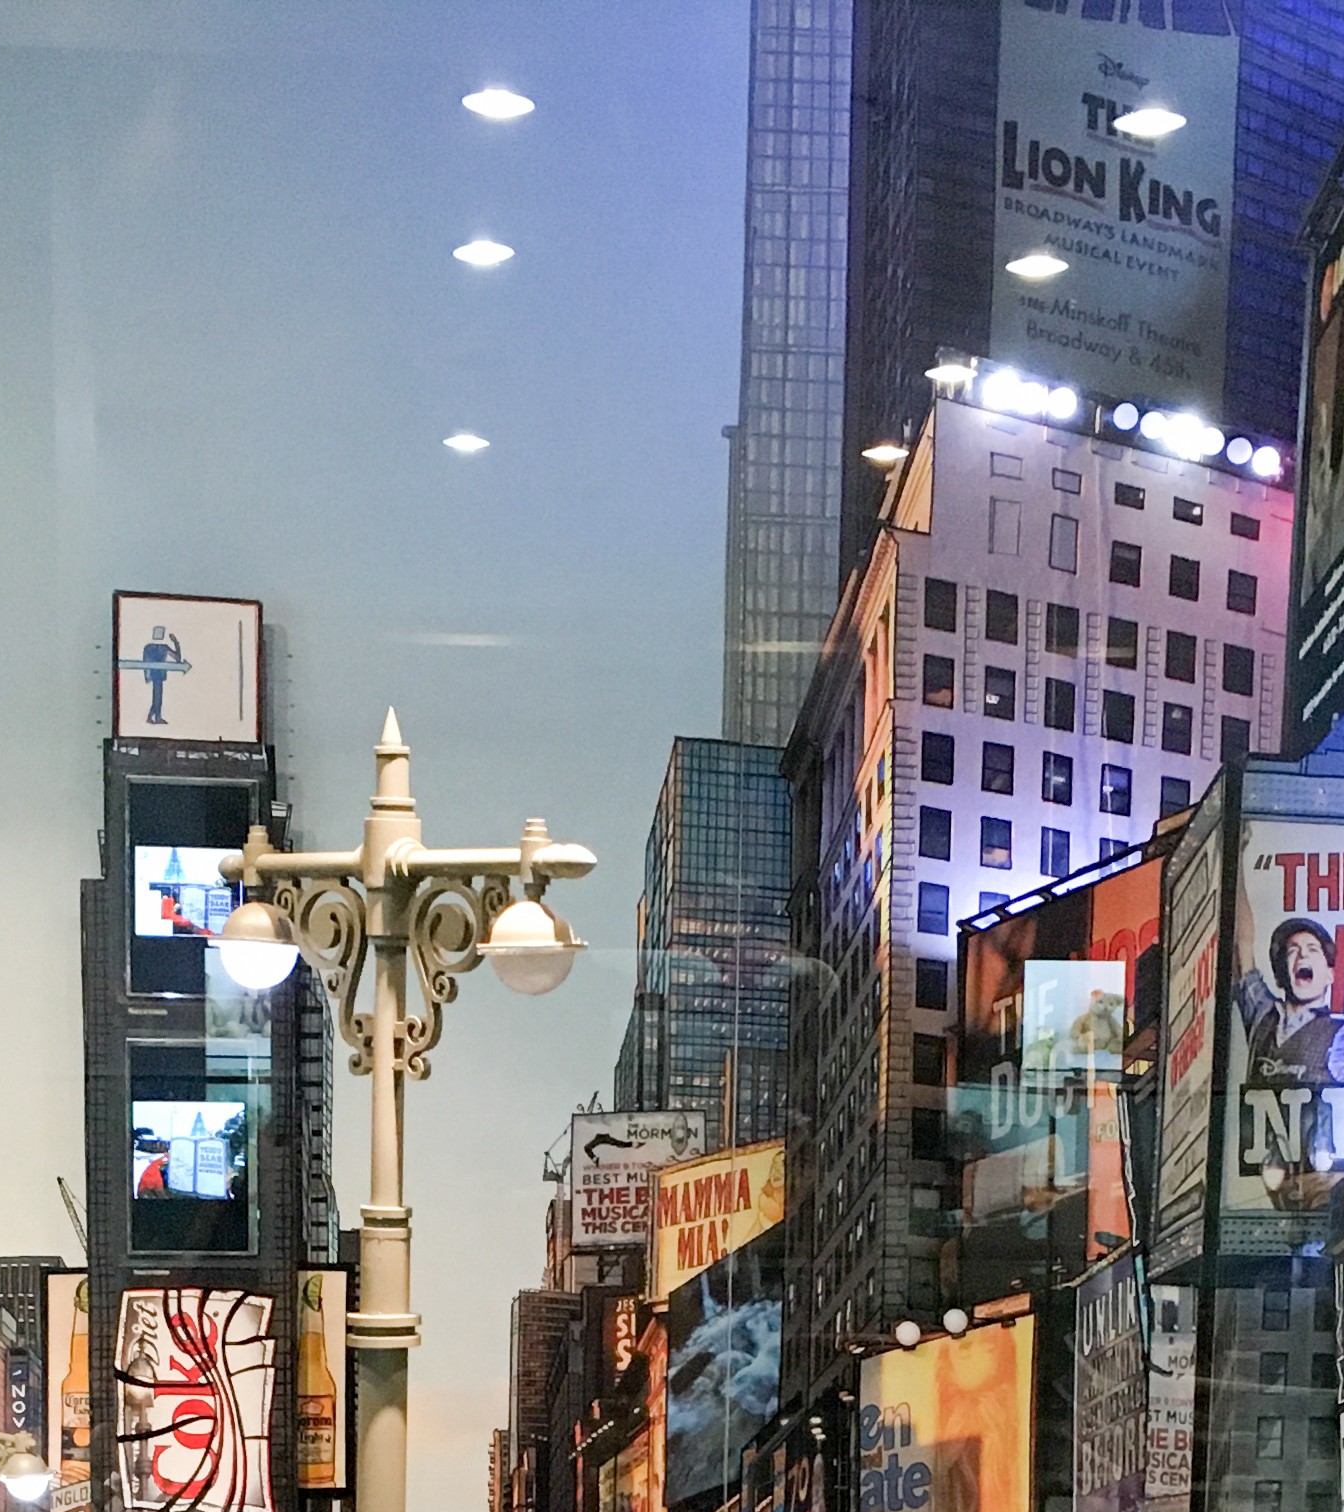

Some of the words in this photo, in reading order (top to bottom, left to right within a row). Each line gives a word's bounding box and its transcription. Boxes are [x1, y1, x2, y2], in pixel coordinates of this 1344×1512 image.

[1002, 120, 1106, 199] LION
[1119, 158, 1221, 238] KING
[1004, 196, 1115, 240] BROADWAY'S
[1121, 229, 1219, 271] LANDMARK
[1045, 232, 1121, 267] MUSICAL
[1126, 260, 1179, 281] EVENT
[1026, 318, 1122, 366] Broadway
[582, 1173, 619, 1186] BEST
[657, 1167, 752, 1229] MAMMA
[582, 1221, 619, 1235] THIS
[677, 1217, 730, 1271] MIA!
[129, 1300, 159, 1366] Diet
[1082, 1277, 1138, 1356] UNLIK
[11, 1384, 26, 1429] NOV
[152, 1310, 218, 1500] Coke
